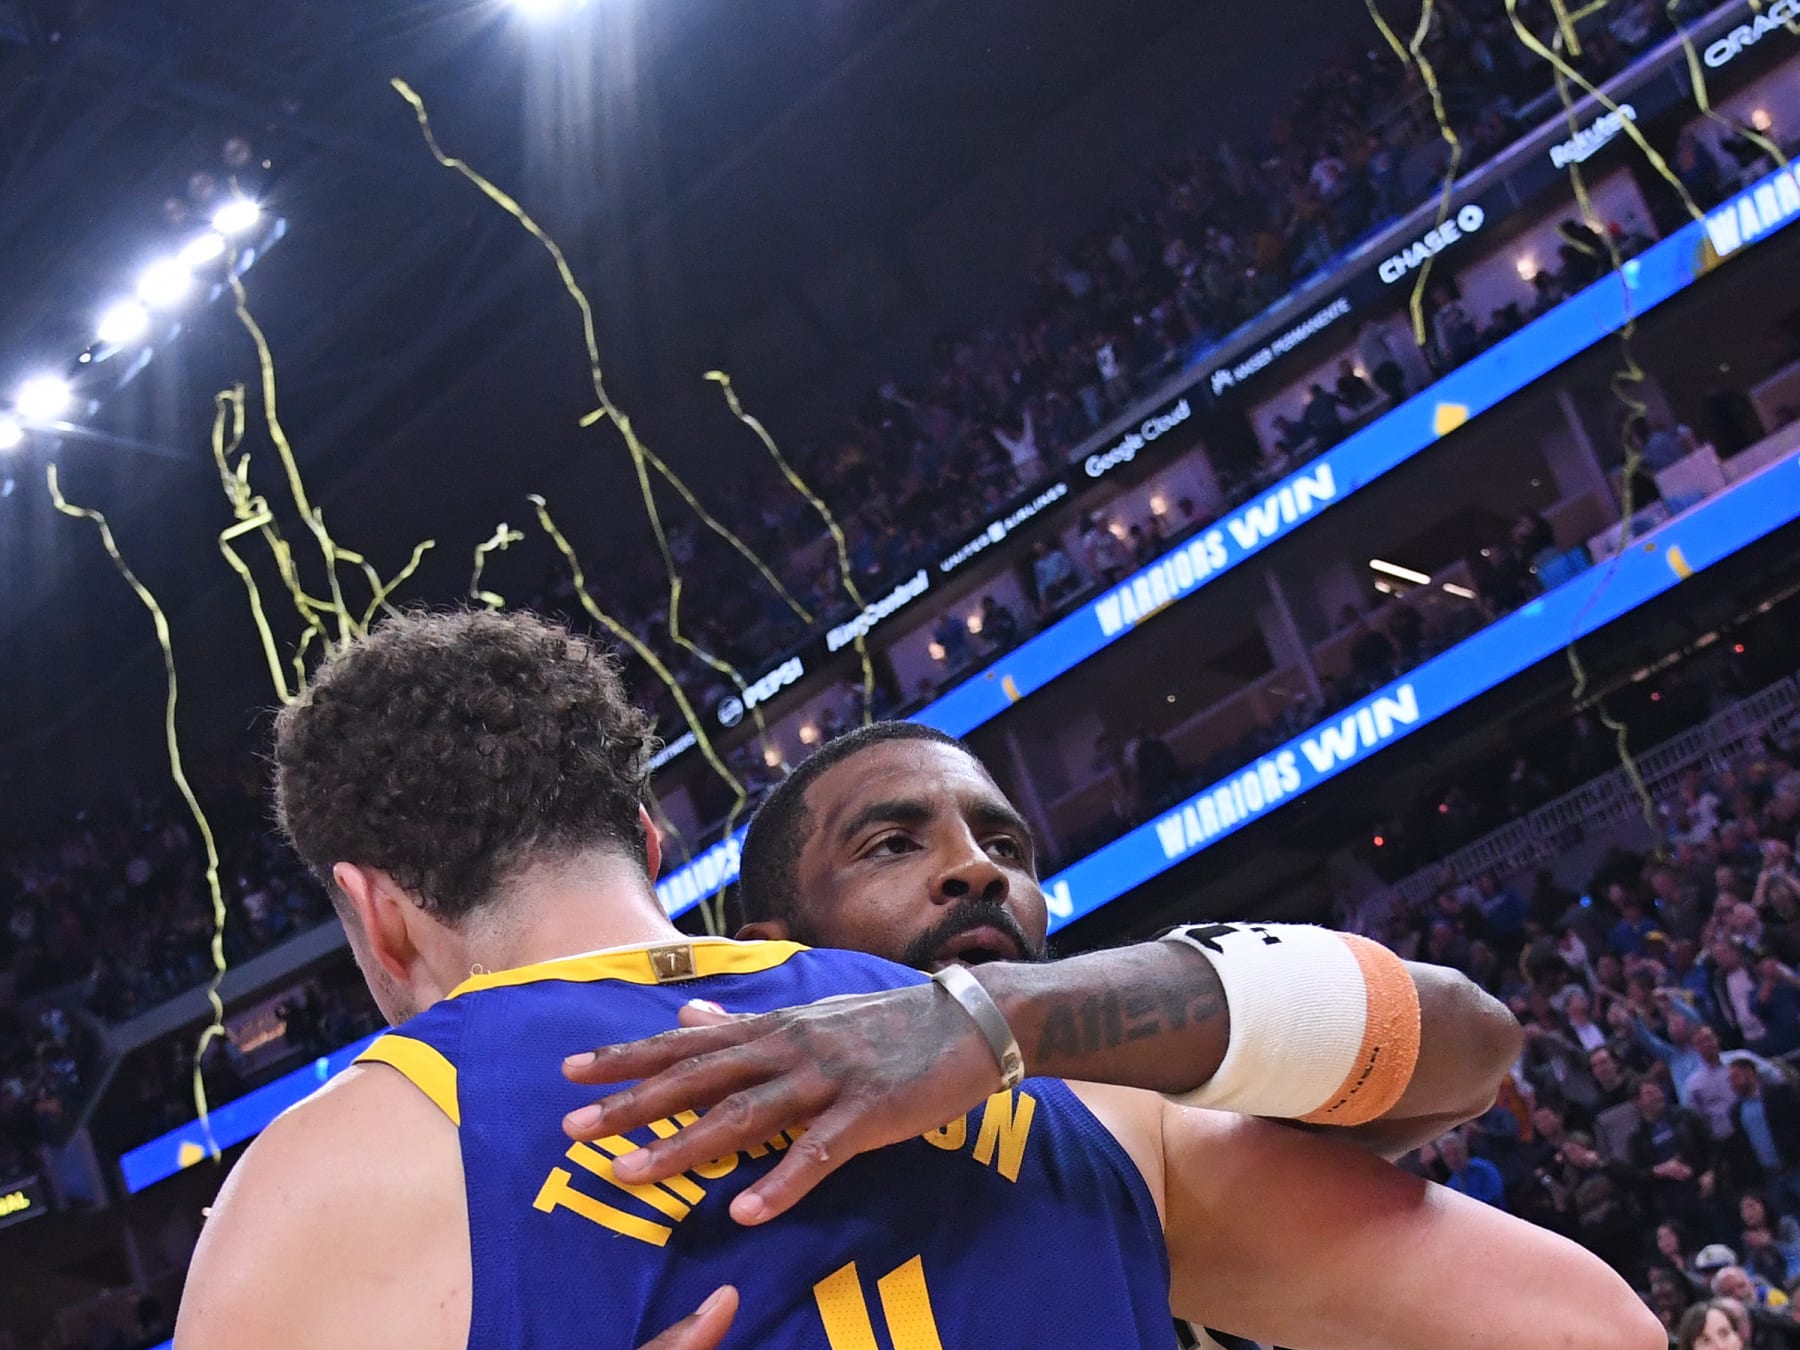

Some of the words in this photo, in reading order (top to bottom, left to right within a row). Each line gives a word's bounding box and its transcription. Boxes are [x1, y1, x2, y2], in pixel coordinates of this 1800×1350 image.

[1703, 0, 1800, 67] ORAC
[1378, 219, 1462, 284] CHASE
[1085, 433, 1145, 477] Google
[1141, 399, 1191, 441] Cloud
[940, 532, 990, 573] UNITED
[1003, 482, 1067, 532] AIRLINES
[1095, 530, 1228, 637] WARRIORS
[1227, 463, 1337, 550] WIN
[742, 657, 804, 709] PEPSI
[1156, 750, 1300, 859] WARRIORS
[1301, 684, 1419, 772] WIN
